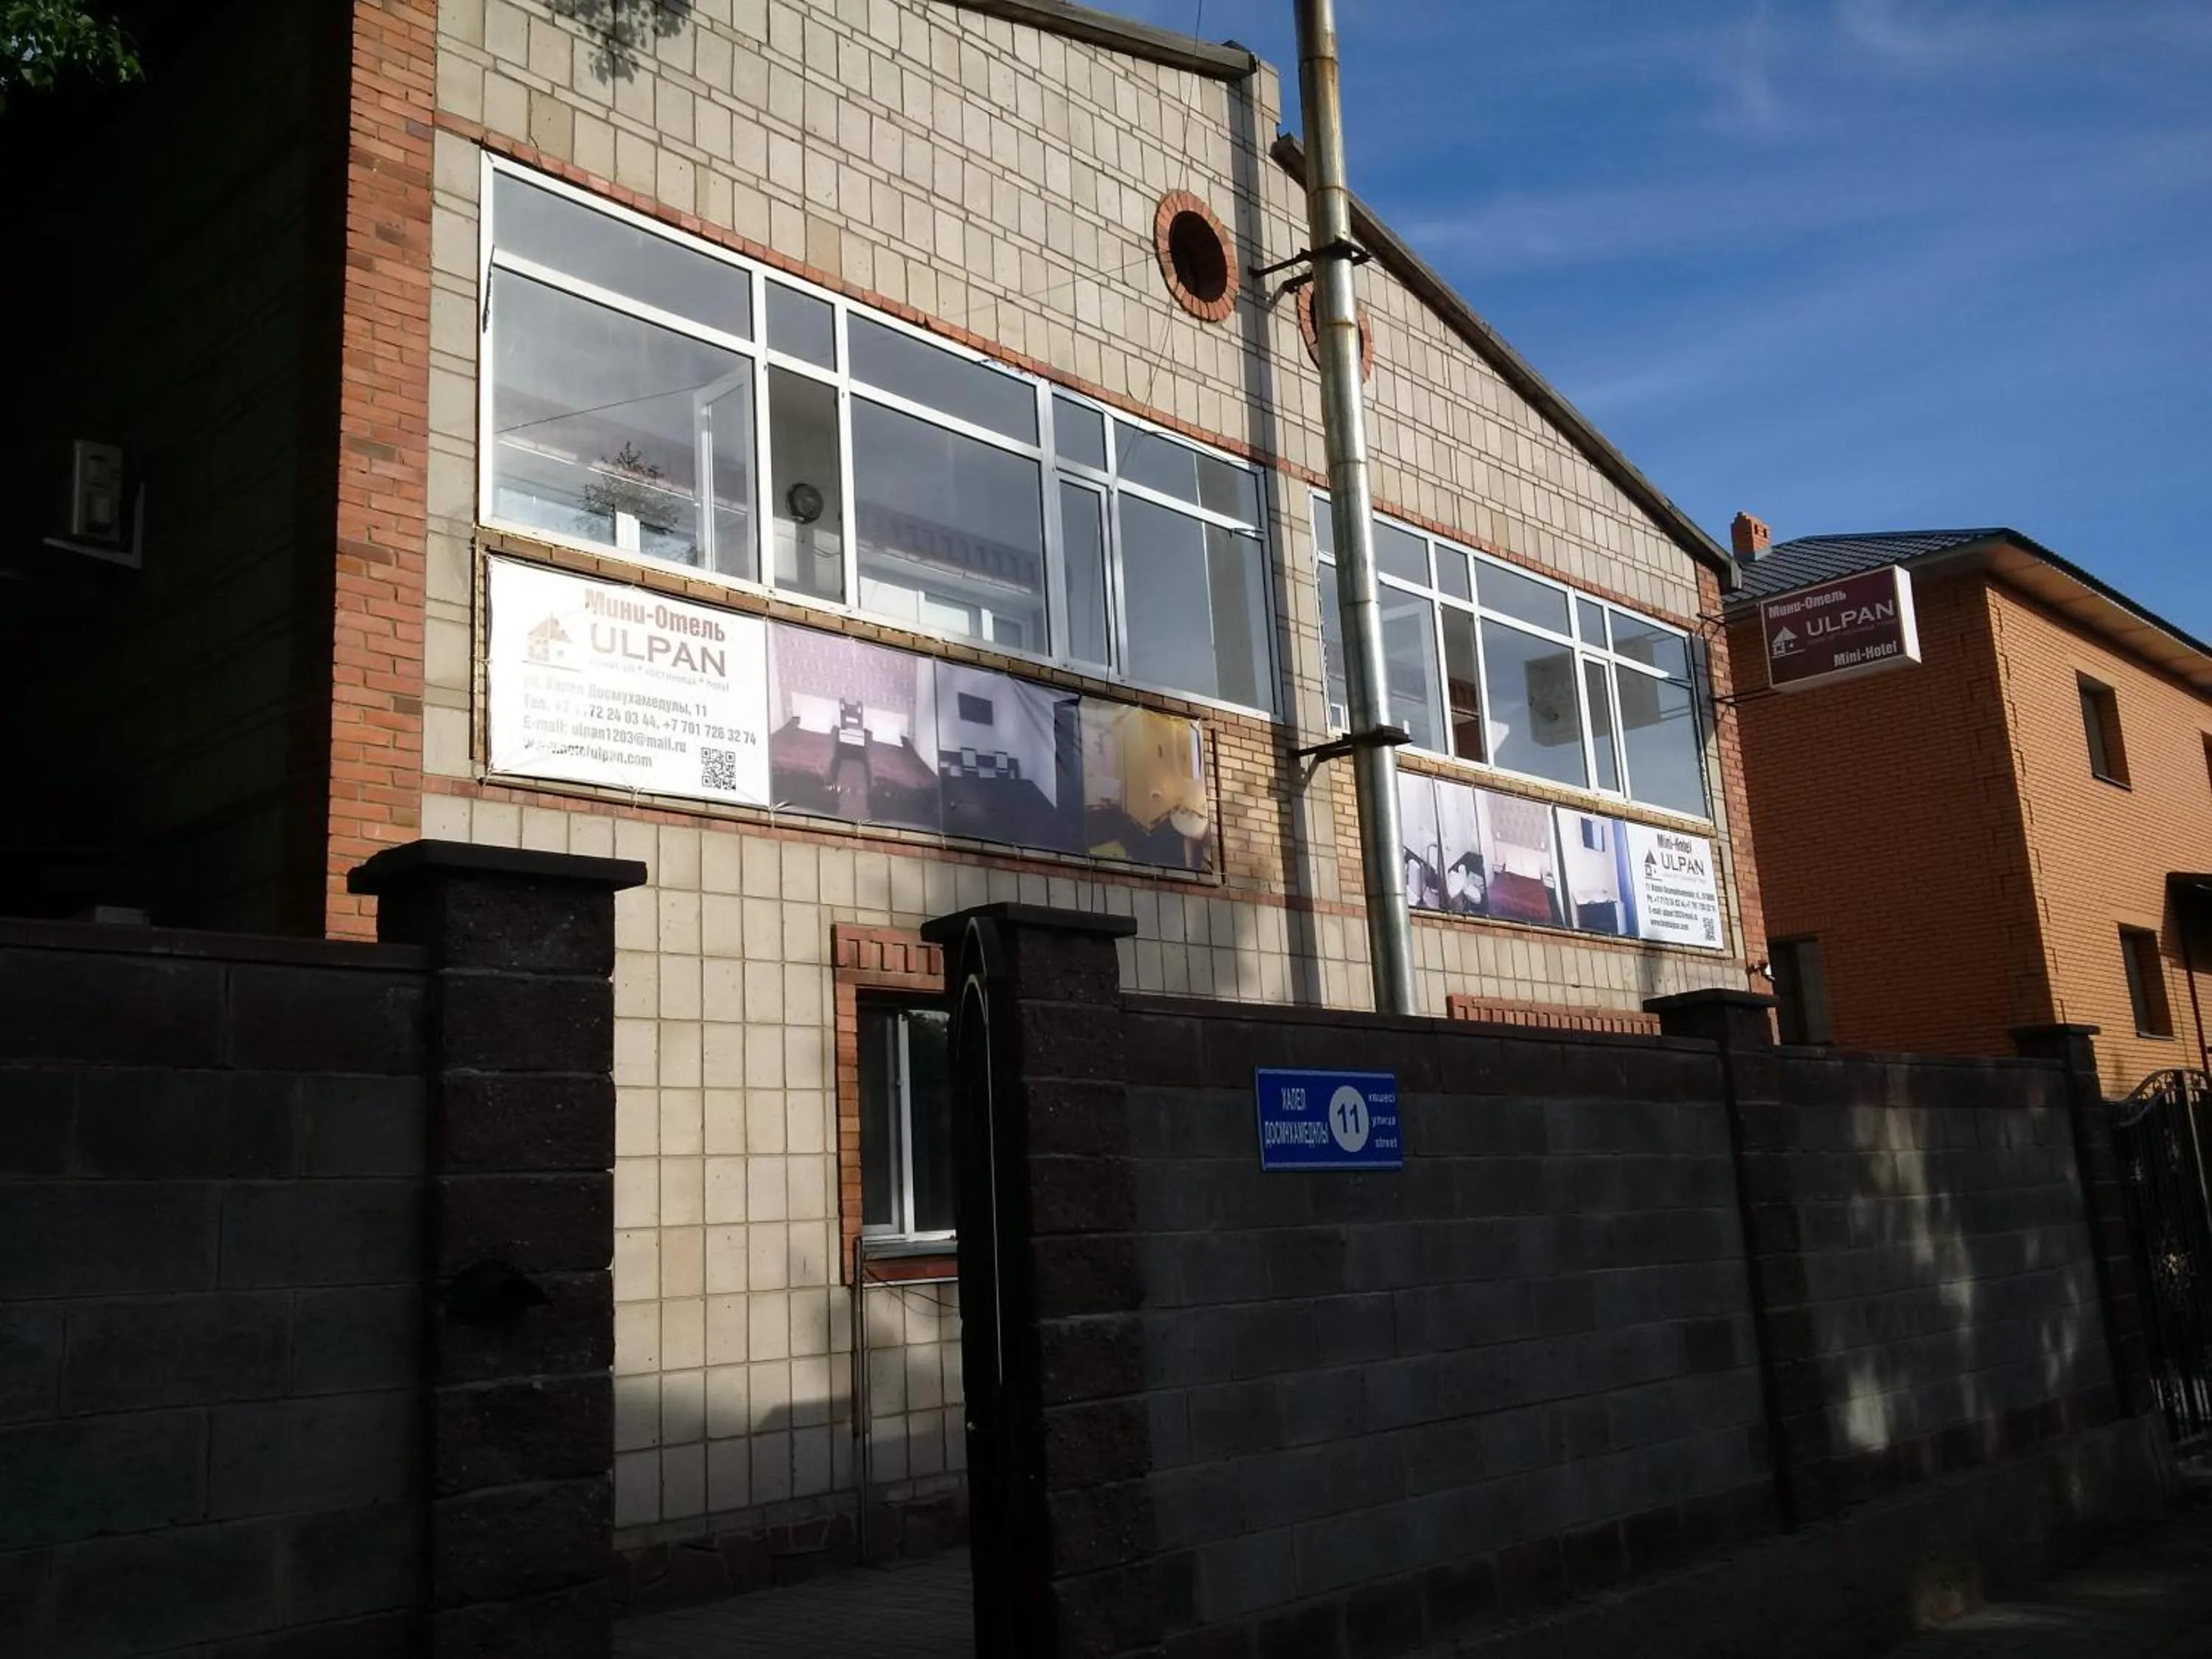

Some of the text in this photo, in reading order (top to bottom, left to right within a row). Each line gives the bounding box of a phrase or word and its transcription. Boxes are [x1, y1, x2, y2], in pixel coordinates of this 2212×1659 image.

[585, 588, 726, 642] Мини-Отель
[1769, 590, 1847, 619] Мини-Отель
[1806, 599, 1894, 637] ULPAN
[590, 623, 726, 677] ULPAN
[1834, 640, 1897, 667] Mini-Hotel
[695, 703, 708, 717] 11
[607, 707, 621, 723] 24
[625, 710, 639, 725] 03
[643, 713, 660, 729] 44,
[663, 717, 678, 734] +7
[681, 719, 700, 736] 701
[728, 728, 741, 742] 32
[743, 730, 757, 745] 74
[1660, 852, 1705, 877] ULPAN
[1337, 1103, 1360, 1134] 11
